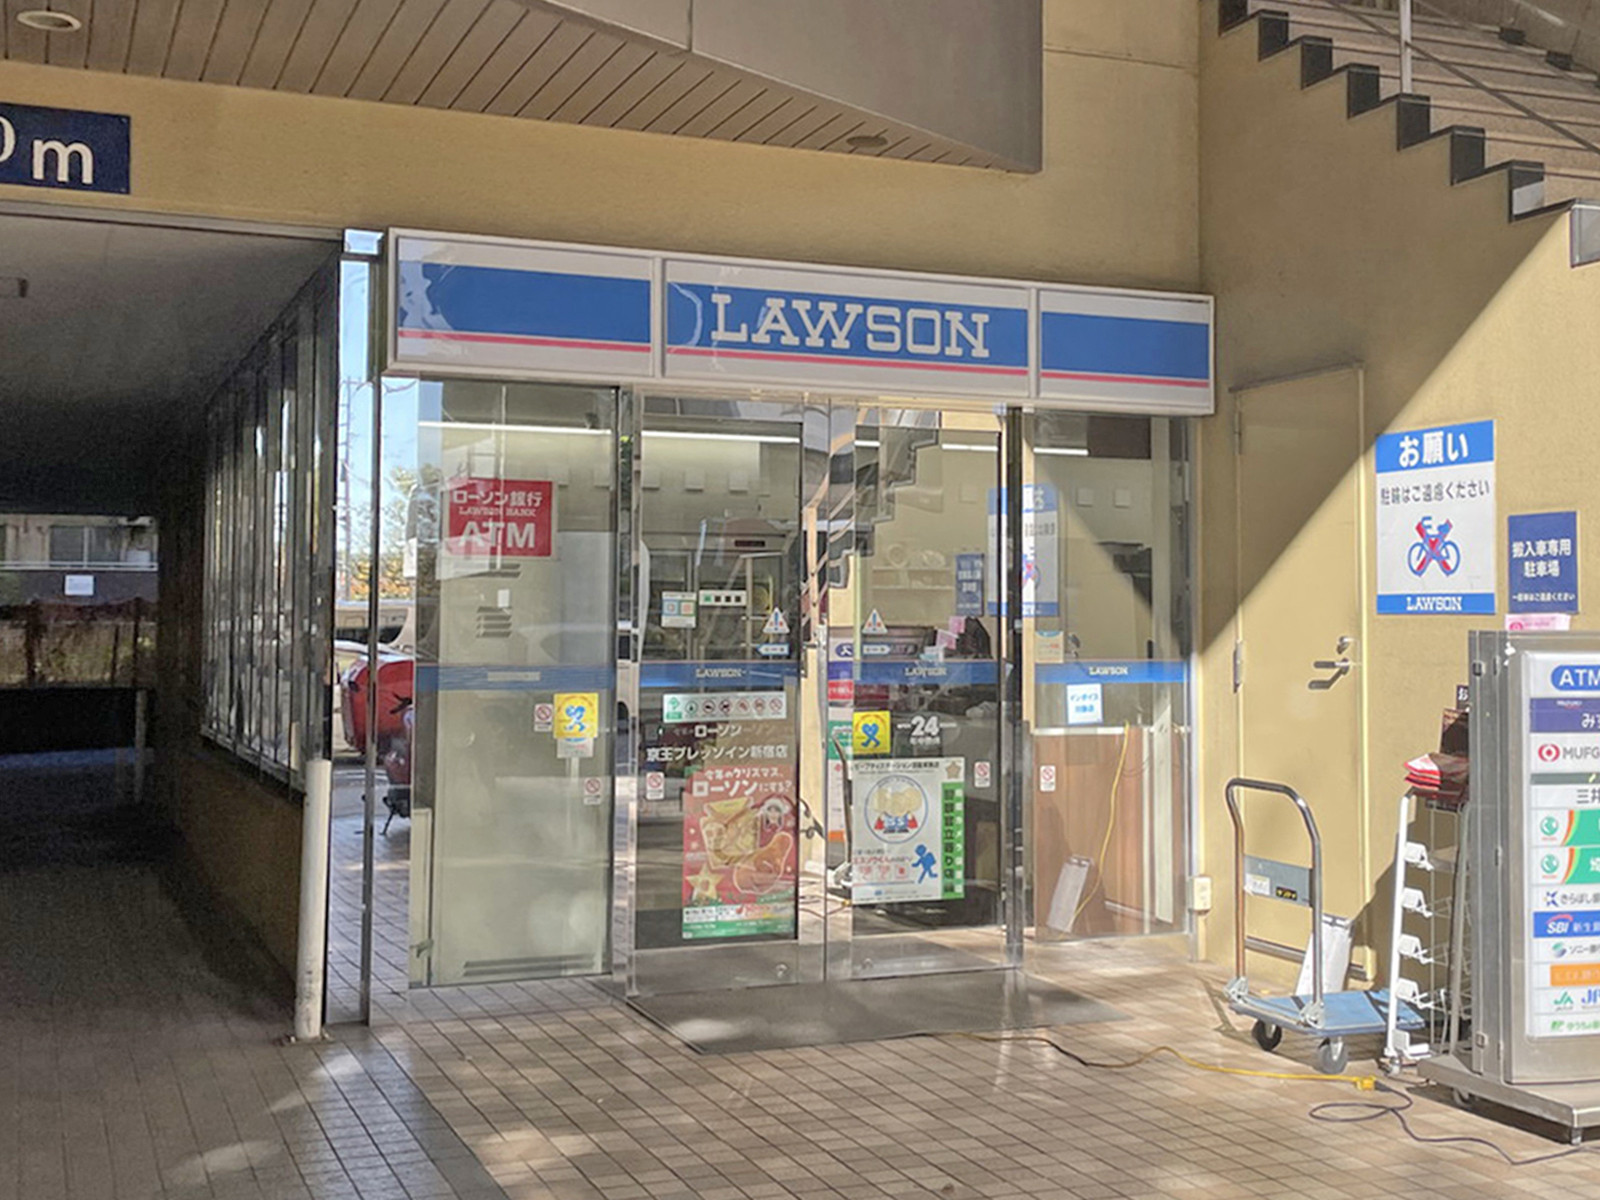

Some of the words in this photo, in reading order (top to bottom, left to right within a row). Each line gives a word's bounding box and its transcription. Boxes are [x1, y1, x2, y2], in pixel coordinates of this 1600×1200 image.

[711, 293, 989, 358] LAWSON
[1399, 431, 1469, 468] お願い
[453, 490, 543, 507] ローソン銀行
[458, 521, 535, 549] ATM
[1406, 597, 1462, 611] LAWSON
[696, 668, 742, 678] LAWSON
[1089, 666, 1128, 675] LAWSON
[1559, 669, 1600, 686] ATM
[694, 725, 742, 737] ローソン
[911, 715, 939, 736] 24
[1562, 746, 1600, 759] MUFG
[1547, 921, 1569, 934] SBI
